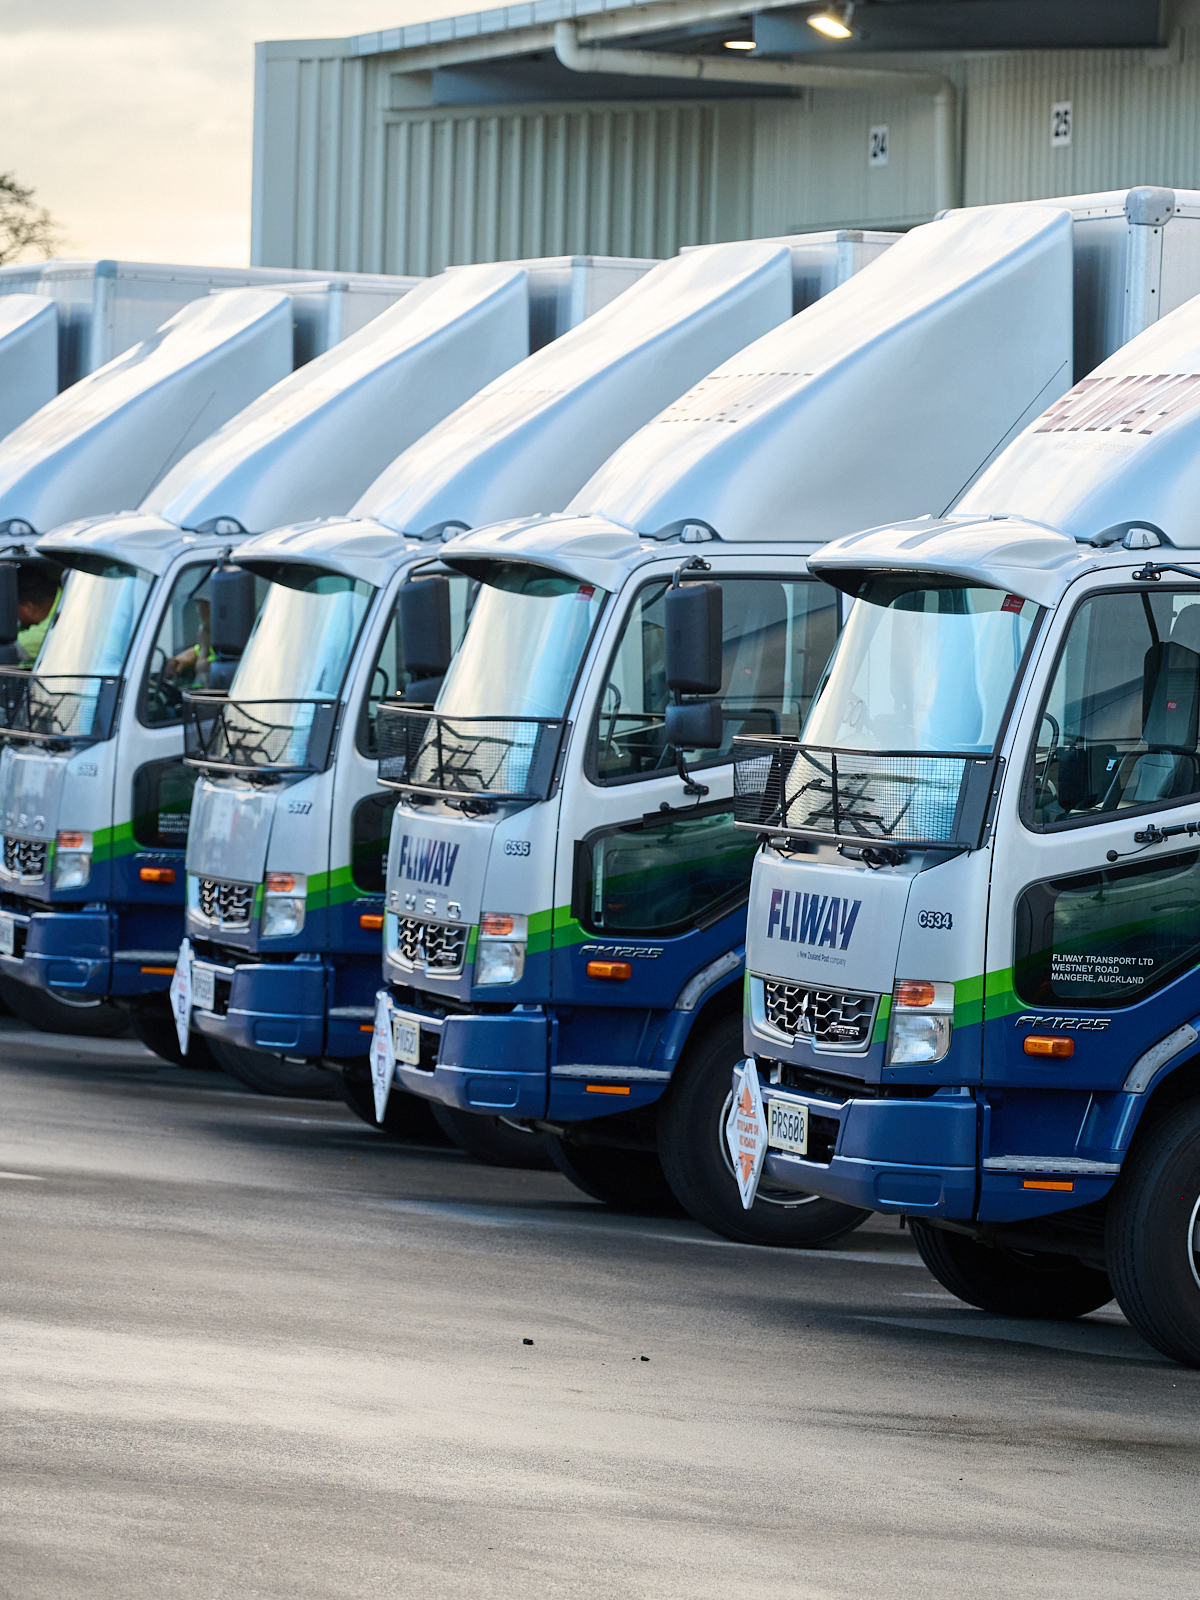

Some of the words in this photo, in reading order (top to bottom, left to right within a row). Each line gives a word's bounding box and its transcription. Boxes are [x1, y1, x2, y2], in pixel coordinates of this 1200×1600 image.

[1054, 109, 1070, 137] 25
[872, 132, 887, 158] 24
[503, 839, 531, 856] C535
[398, 834, 461, 887] FLIWAY
[766, 888, 862, 951] FLIWAY
[917, 910, 953, 930] C534
[578, 944, 664, 958] FK1225
[1052, 953, 1084, 963] FLIWAY
[1085, 955, 1137, 965] TRANSPORT
[1138, 958, 1154, 966] LTD
[1051, 963, 1094, 972] WESTNEY
[1094, 965, 1120, 974] ROAD
[1051, 973, 1096, 983] MANGERE,
[1097, 975, 1145, 984] AUCKLAND
[1014, 1014, 1112, 1031] FK1225
[771, 1109, 805, 1143] PRS608
